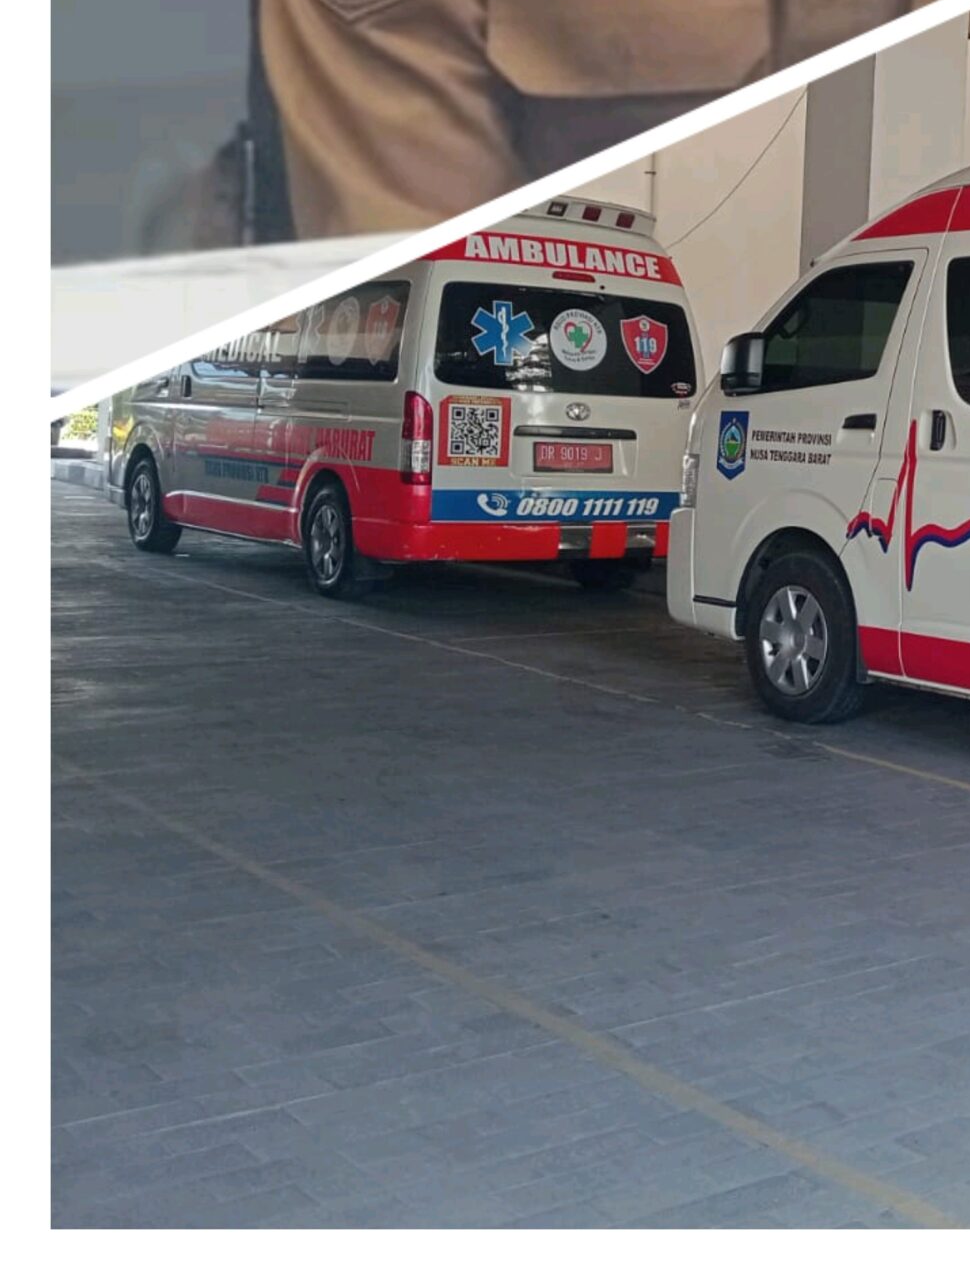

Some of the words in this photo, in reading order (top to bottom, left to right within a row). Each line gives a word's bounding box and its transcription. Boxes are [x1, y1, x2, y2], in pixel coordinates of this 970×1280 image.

[465, 234, 661, 280] AMBULANCE
[634, 336, 657, 353] 119
[752, 430, 796, 443] PEMERINTAH
[798, 433, 832, 446] PROVINSI
[451, 457, 479, 465] SCAN
[560, 446, 588, 460] 9019
[750, 449, 768, 460] NUSA
[769, 450, 806, 463] TENGGARA
[808, 453, 832, 465] BARAT
[516, 498, 579, 516] 0800
[582, 498, 624, 516] 1111
[627, 498, 659, 516] 119
